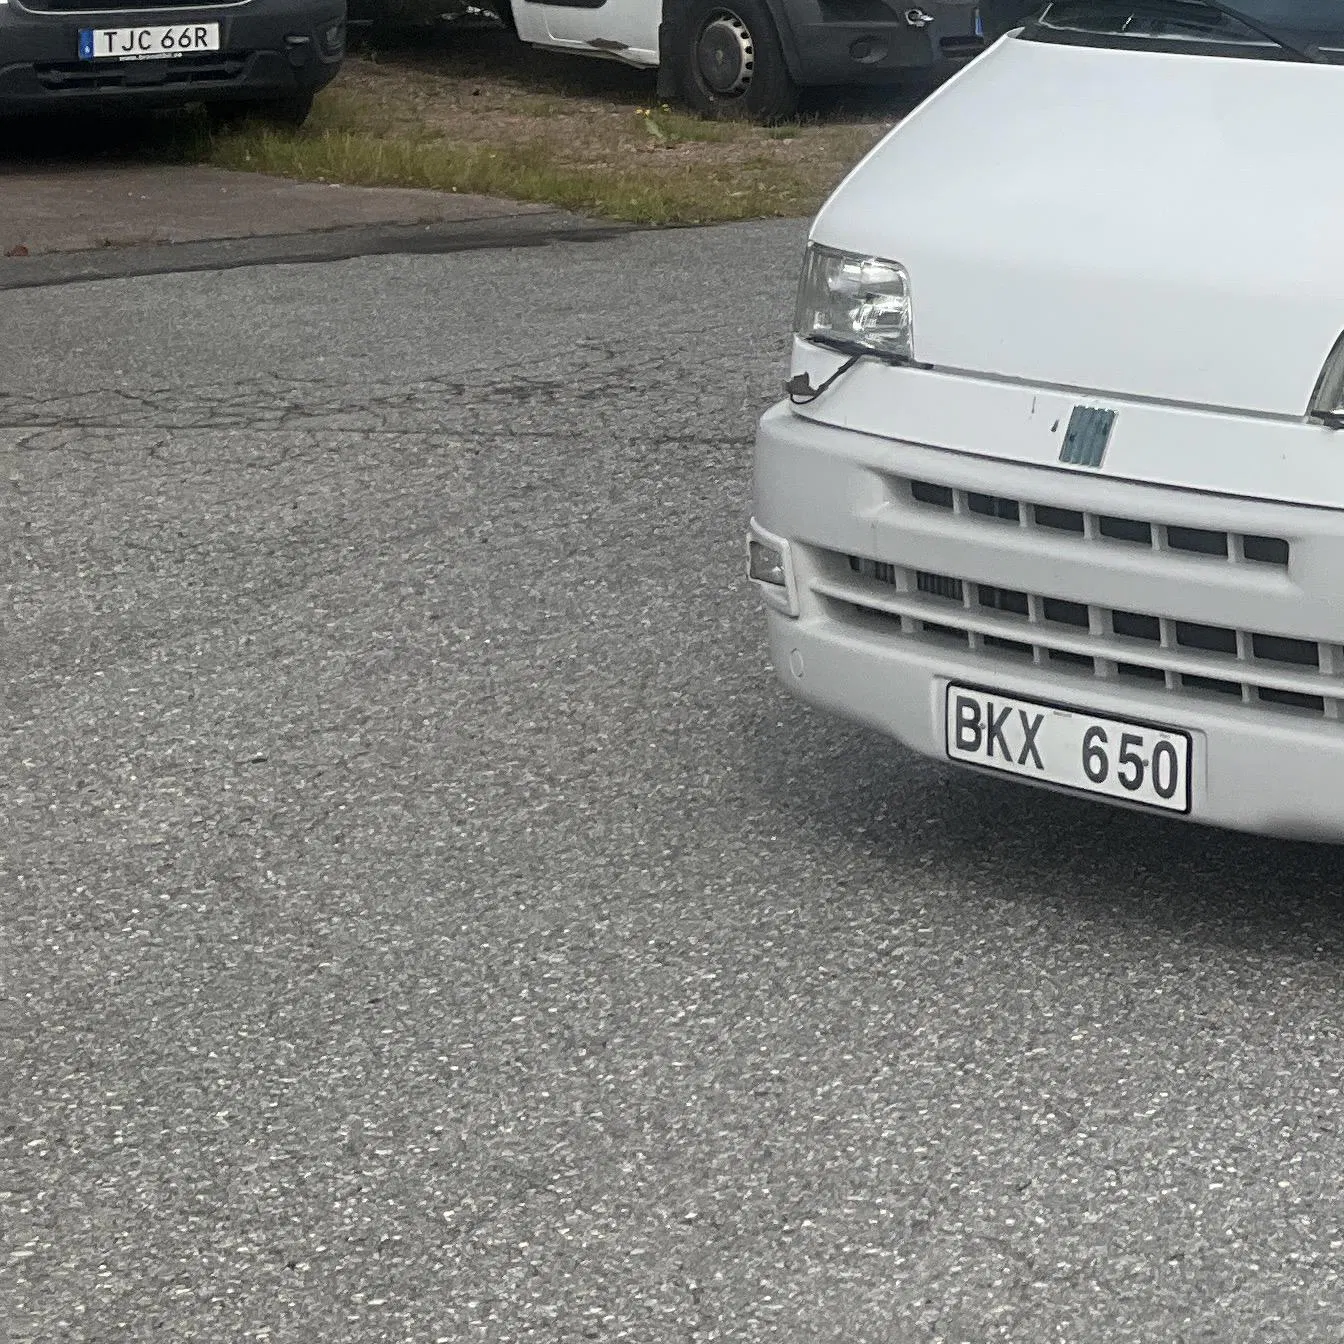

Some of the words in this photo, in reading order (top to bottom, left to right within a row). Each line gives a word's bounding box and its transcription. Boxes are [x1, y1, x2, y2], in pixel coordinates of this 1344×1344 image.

[103, 30, 152, 53] TJC
[160, 27, 208, 49] 66R
[956, 695, 1045, 770] BKX
[1082, 725, 1179, 800] 650
